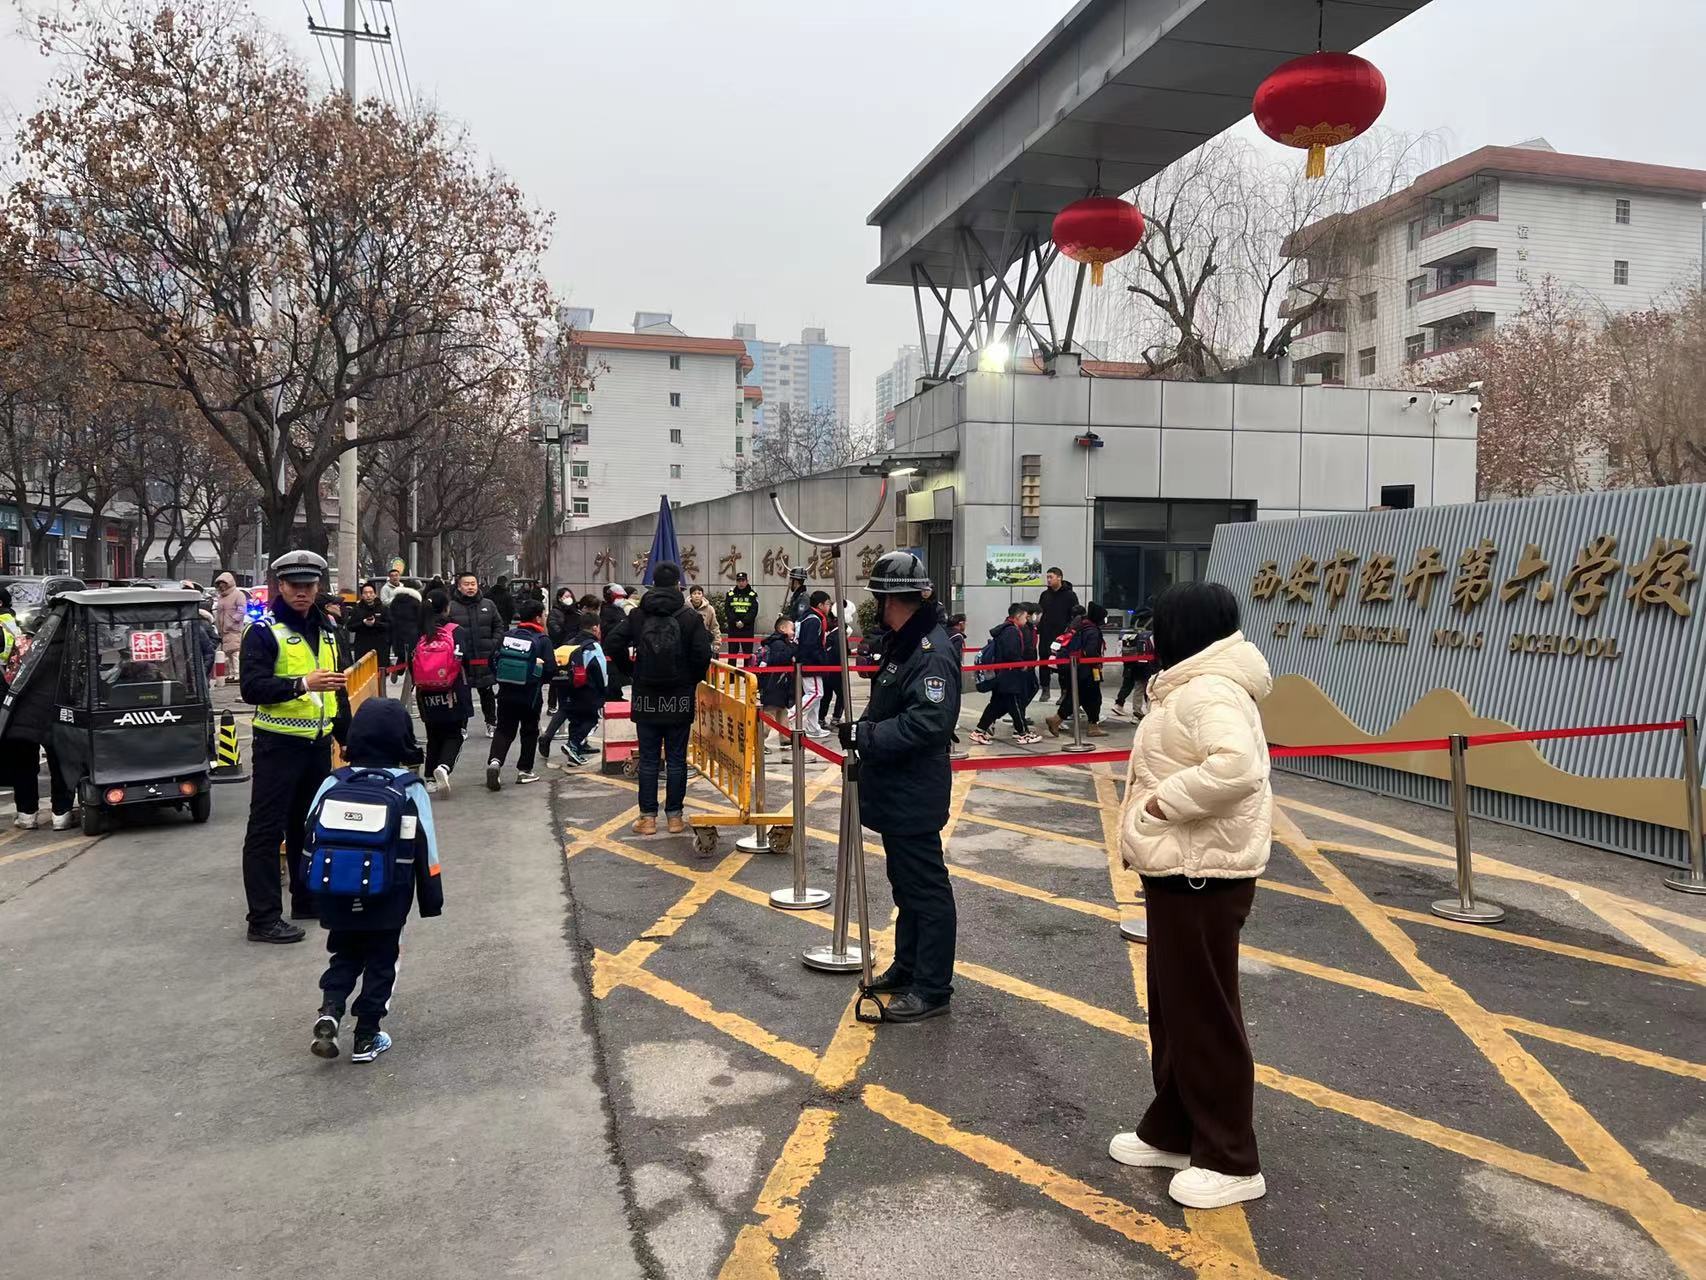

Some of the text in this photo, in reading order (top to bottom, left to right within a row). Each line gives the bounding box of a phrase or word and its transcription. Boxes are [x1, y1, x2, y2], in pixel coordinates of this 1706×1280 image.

[1252, 534, 1698, 618] 西安市经开第六学校
[1432, 629, 1484, 650] NO.6
[1508, 633, 1622, 659] SCHOOL
